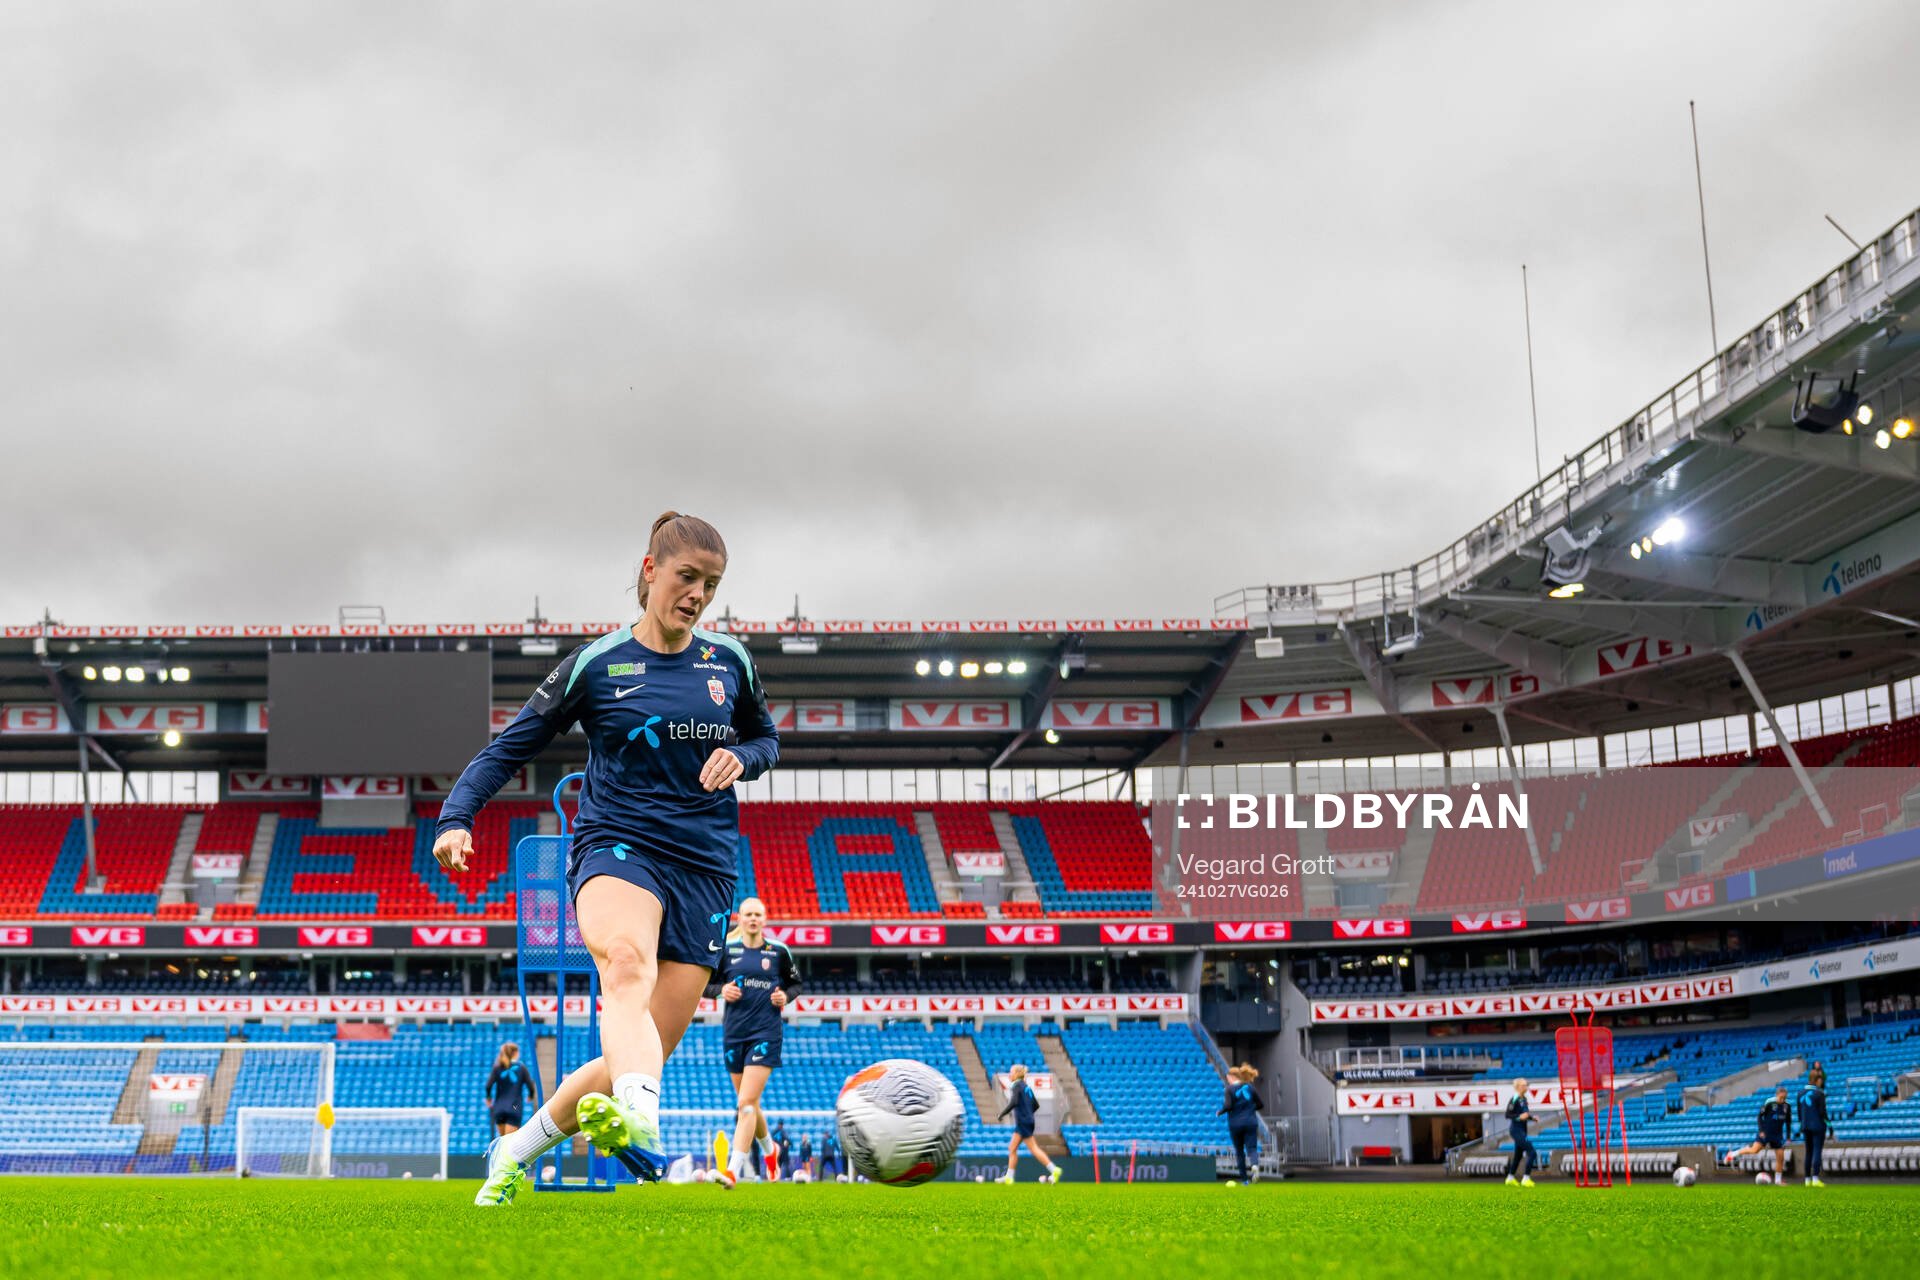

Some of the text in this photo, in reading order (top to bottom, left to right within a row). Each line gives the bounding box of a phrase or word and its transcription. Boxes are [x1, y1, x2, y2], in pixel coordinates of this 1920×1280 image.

[1763, 605, 1793, 623] tele
[5, 626, 43, 638] VG
[52, 626, 90, 638] VG
[100, 626, 138, 638] VG
[147, 625, 186, 637] VG
[195, 625, 234, 637] VG
[243, 625, 282, 637] VG
[292, 625, 330, 636] VG
[340, 625, 378, 636] VG
[388, 624, 427, 636] VG
[436, 624, 475, 636] VG
[485, 624, 524, 635] VG
[534, 623, 572, 635] VG
[728, 621, 766, 633] VG
[776, 621, 814, 633] VG
[824, 621, 863, 633] VG
[873, 621, 912, 633] VG
[922, 621, 960, 632] VG
[970, 621, 1008, 632] VG
[1018, 620, 1057, 632] VG
[1066, 620, 1105, 632] VG
[1114, 620, 1153, 632] VG
[1162, 620, 1201, 631] VG
[1210, 619, 1248, 631] VG
[902, 703, 1009, 728] VG
[1053, 702, 1160, 727] VG
[1241, 689, 1352, 722] VG
[0, 706, 57, 731] G
[99, 706, 204, 731] VG
[229, 773, 309, 791] VG
[324, 777, 405, 795] VG
[0, 926, 33, 947] G
[74, 927, 142, 946] VG
[187, 927, 256, 946] VG
[301, 927, 370, 946] VG
[415, 927, 485, 946] VG
[874, 926, 943, 945] VG
[988, 925, 1058, 944] VG
[1102, 924, 1172, 943] VG
[1217, 922, 1288, 941] VG
[1336, 920, 1408, 938] VG
[1456, 909, 1524, 932] VG
[1569, 897, 1629, 923] VG
[1668, 883, 1713, 911] VG
[1, 998, 55, 1013] VG
[66, 998, 121, 1013] VG
[131, 998, 186, 1013] VG
[197, 998, 253, 1013] VG
[263, 998, 318, 1013] VG
[329, 998, 385, 1013] VG
[395, 998, 451, 1013] VG
[462, 998, 518, 1013] VG
[796, 997, 851, 1012] VG
[862, 997, 918, 1012] VG
[928, 997, 985, 1012] VG
[995, 996, 1051, 1012] VG
[1061, 996, 1117, 1012] VG
[1128, 996, 1183, 1011] VG
[1315, 976, 1733, 1019] VG VG VG VG VG VG VG
[150, 1076, 205, 1090] VG
[1348, 1093, 1414, 1108] VG
[1435, 1090, 1498, 1106] VG
